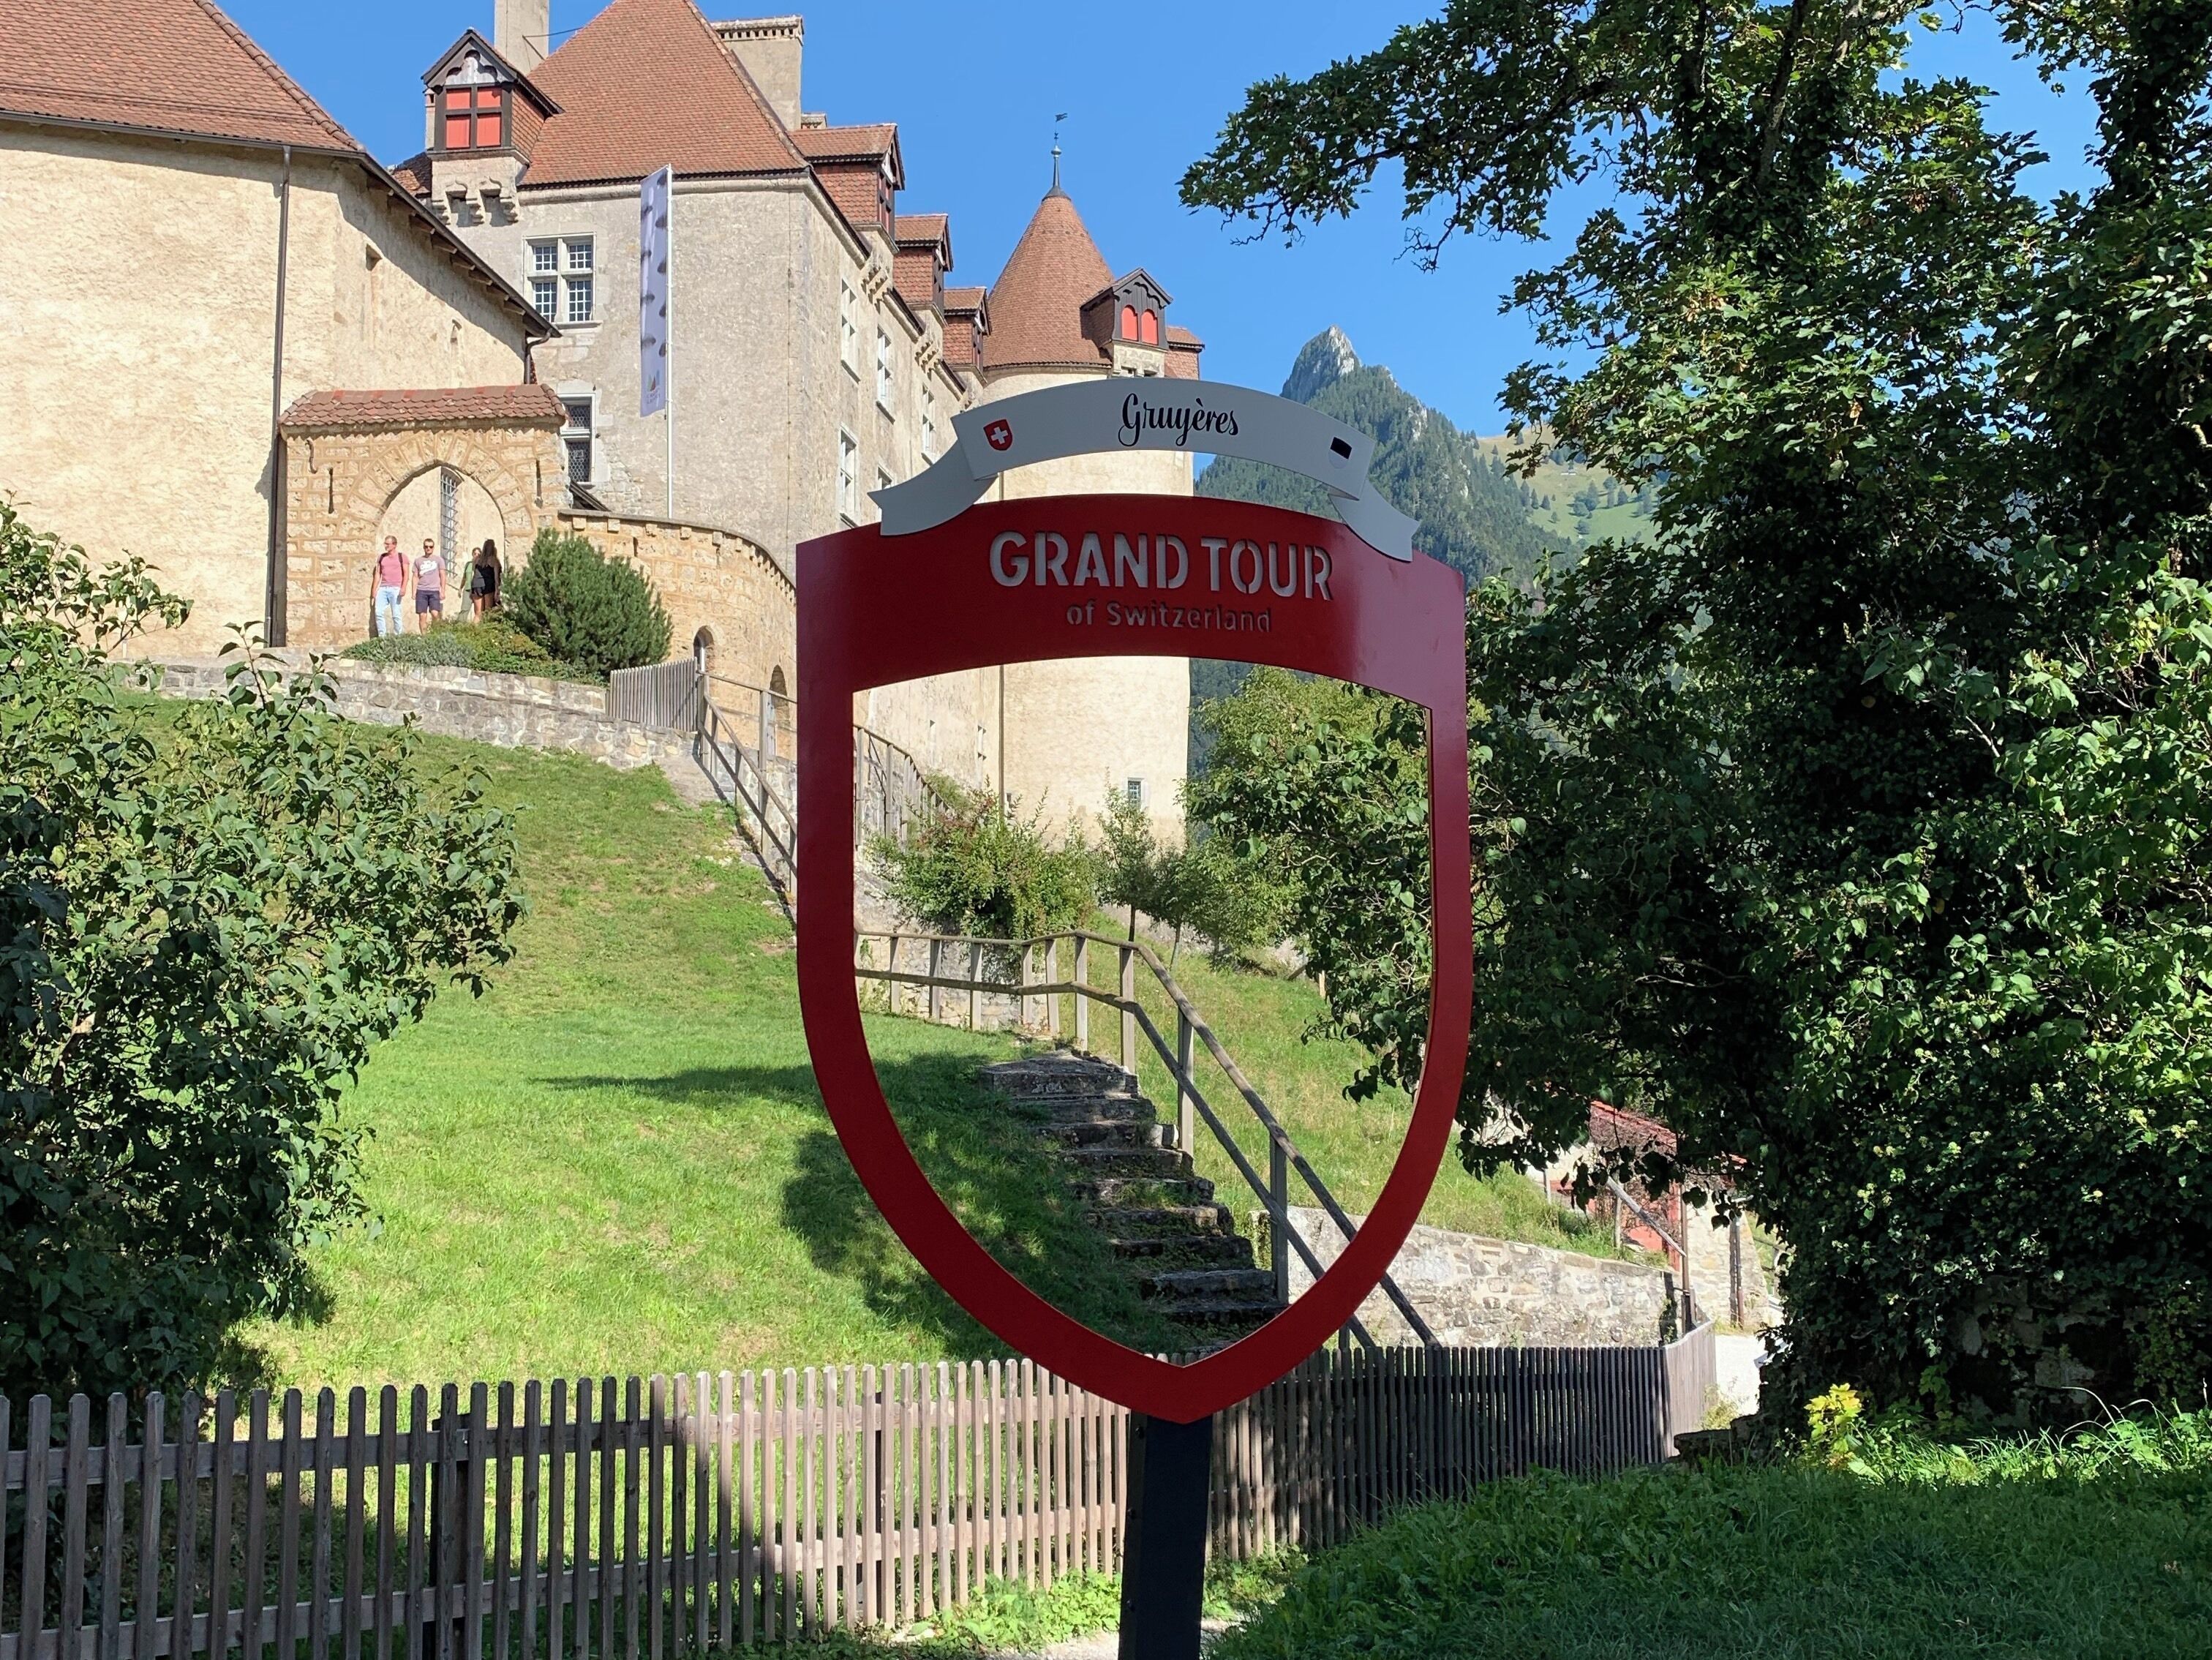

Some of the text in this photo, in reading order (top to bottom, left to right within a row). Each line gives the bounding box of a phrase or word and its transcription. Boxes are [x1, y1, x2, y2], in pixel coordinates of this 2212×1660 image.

[1118, 393, 1239, 447] Gruyères
[990, 531, 1333, 601] GRAND TOUR
[1067, 601, 1271, 632] of Switzerland
